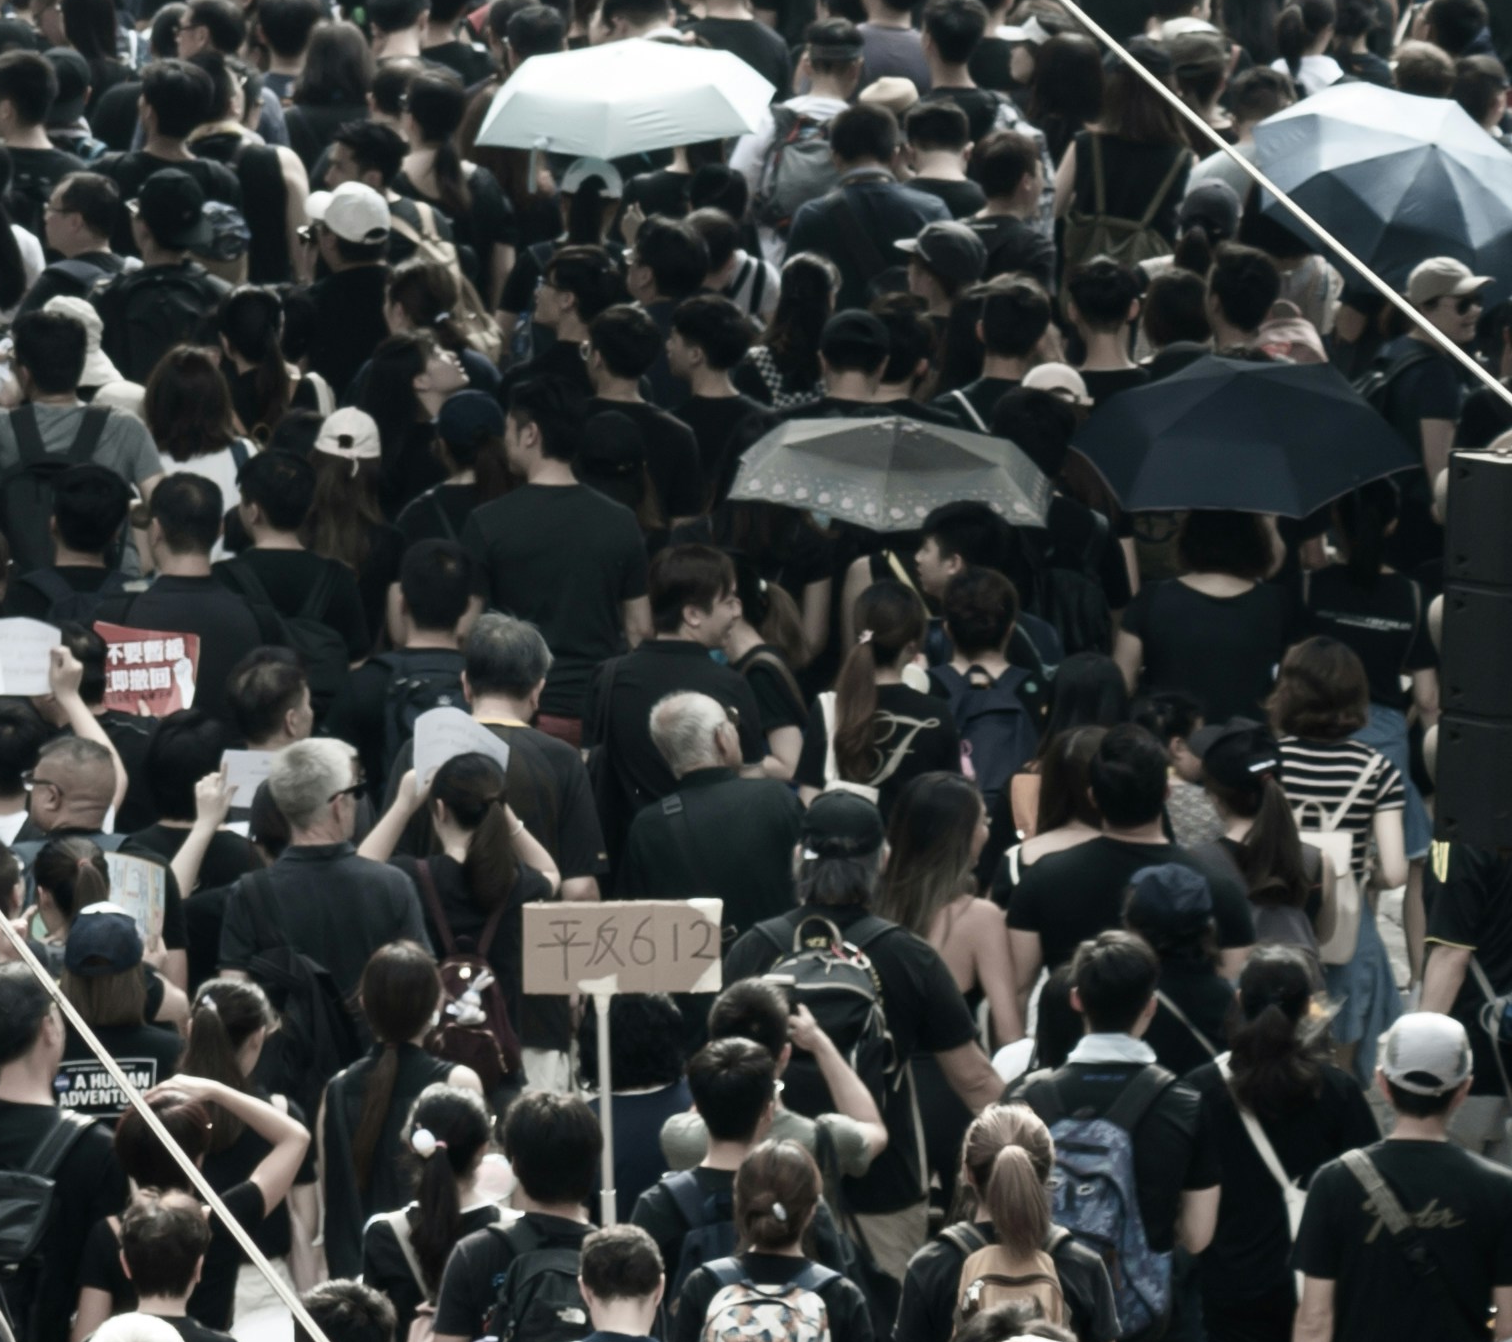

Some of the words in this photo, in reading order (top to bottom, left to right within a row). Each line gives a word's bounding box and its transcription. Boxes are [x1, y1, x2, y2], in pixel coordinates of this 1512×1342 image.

[536, 918, 716, 981] 平反612
[75, 1073, 87, 1090] A
[89, 1071, 150, 1090] HUAN
[59, 1089, 147, 1108] ADVENTU
